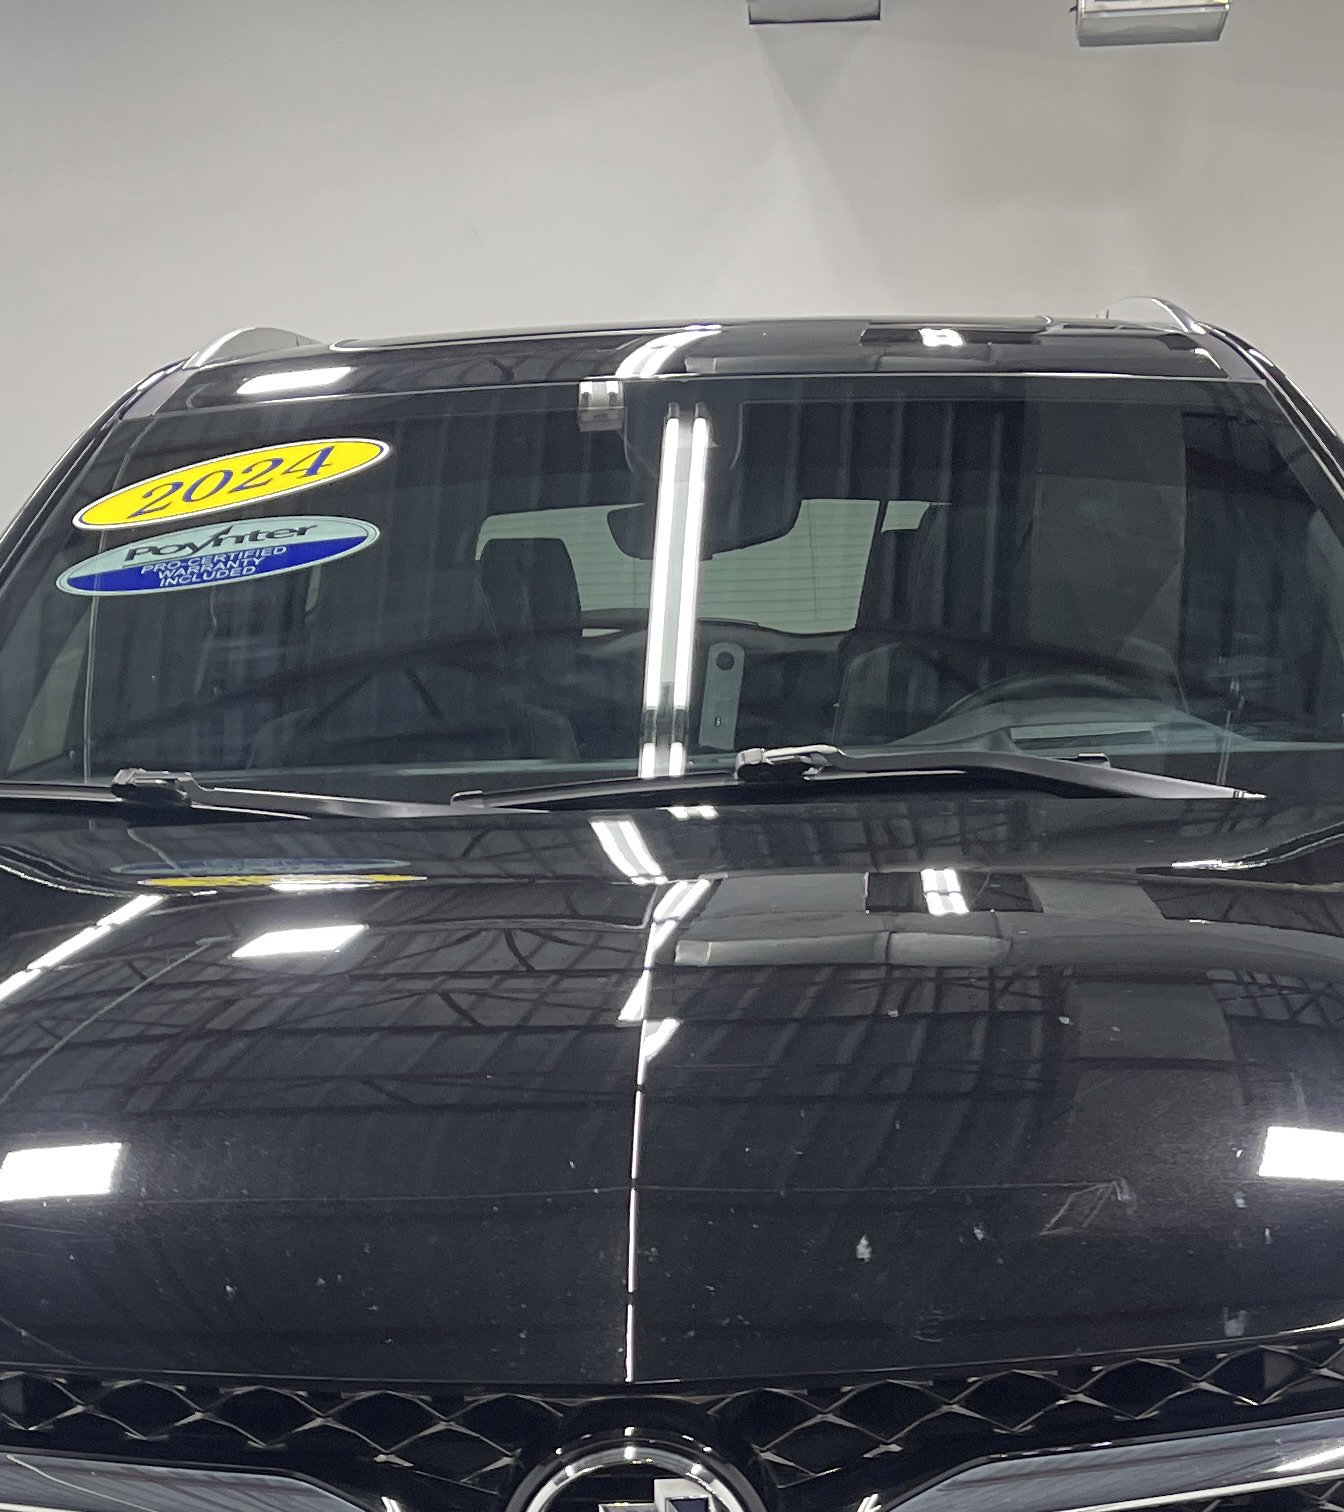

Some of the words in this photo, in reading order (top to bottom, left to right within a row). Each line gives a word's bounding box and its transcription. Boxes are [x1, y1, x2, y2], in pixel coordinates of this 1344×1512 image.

[127, 445, 335, 519] 2024
[124, 525, 318, 562] Poynter
[140, 546, 287, 575] PRO-CERTIFIED
[158, 557, 264, 579] WARRANTY
[159, 566, 256, 587] INCLUDED
